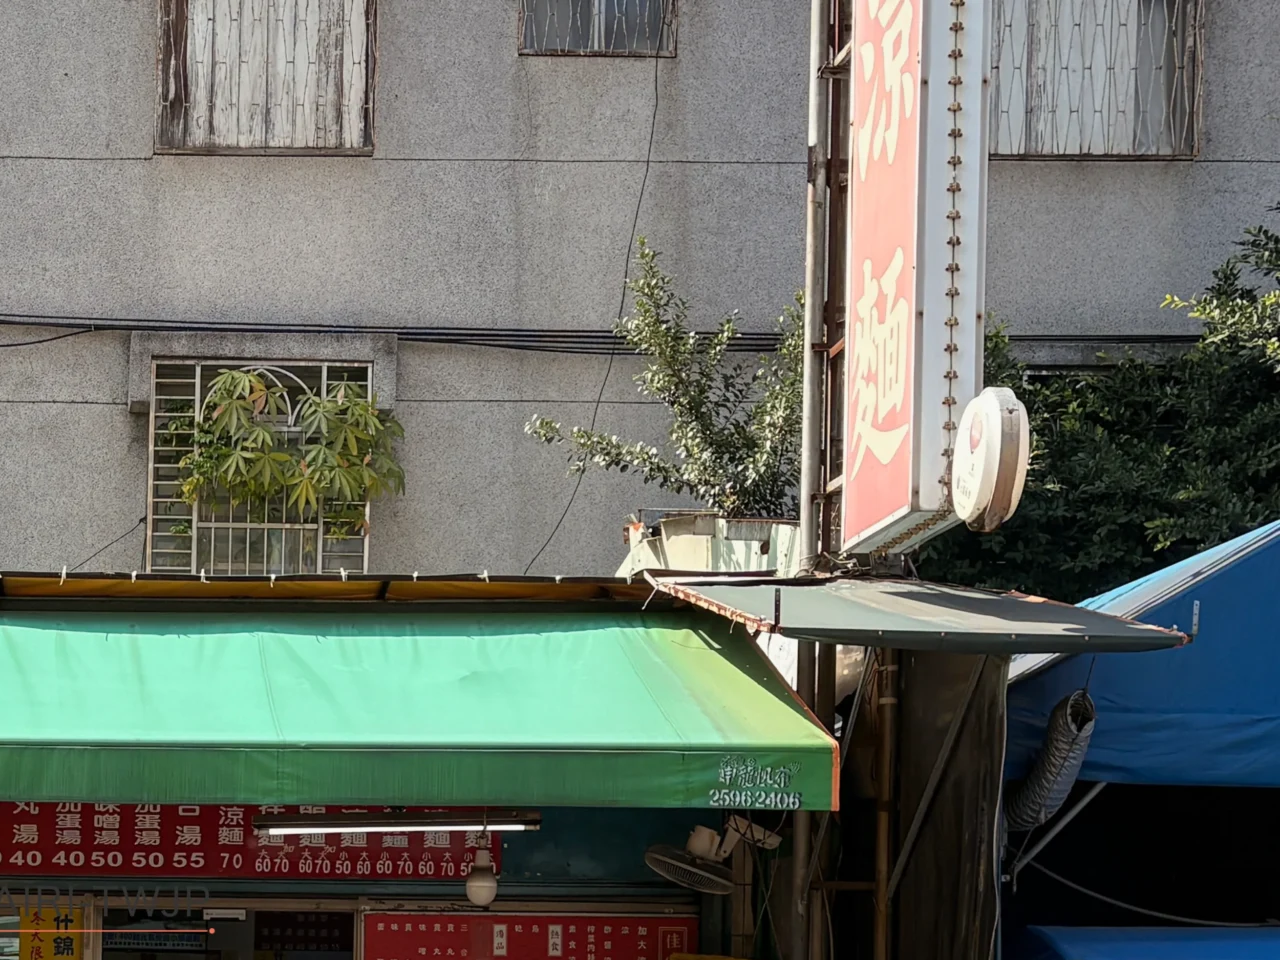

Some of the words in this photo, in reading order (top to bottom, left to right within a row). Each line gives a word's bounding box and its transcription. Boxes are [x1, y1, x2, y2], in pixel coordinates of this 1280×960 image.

[851, 0, 914, 480] 涼麵
[9, 850, 43, 867] 40
[52, 851, 86, 867] 40
[90, 851, 123, 867] 50
[132, 852, 165, 868] 50
[172, 852, 205, 868] 55
[220, 853, 243, 869] 70
